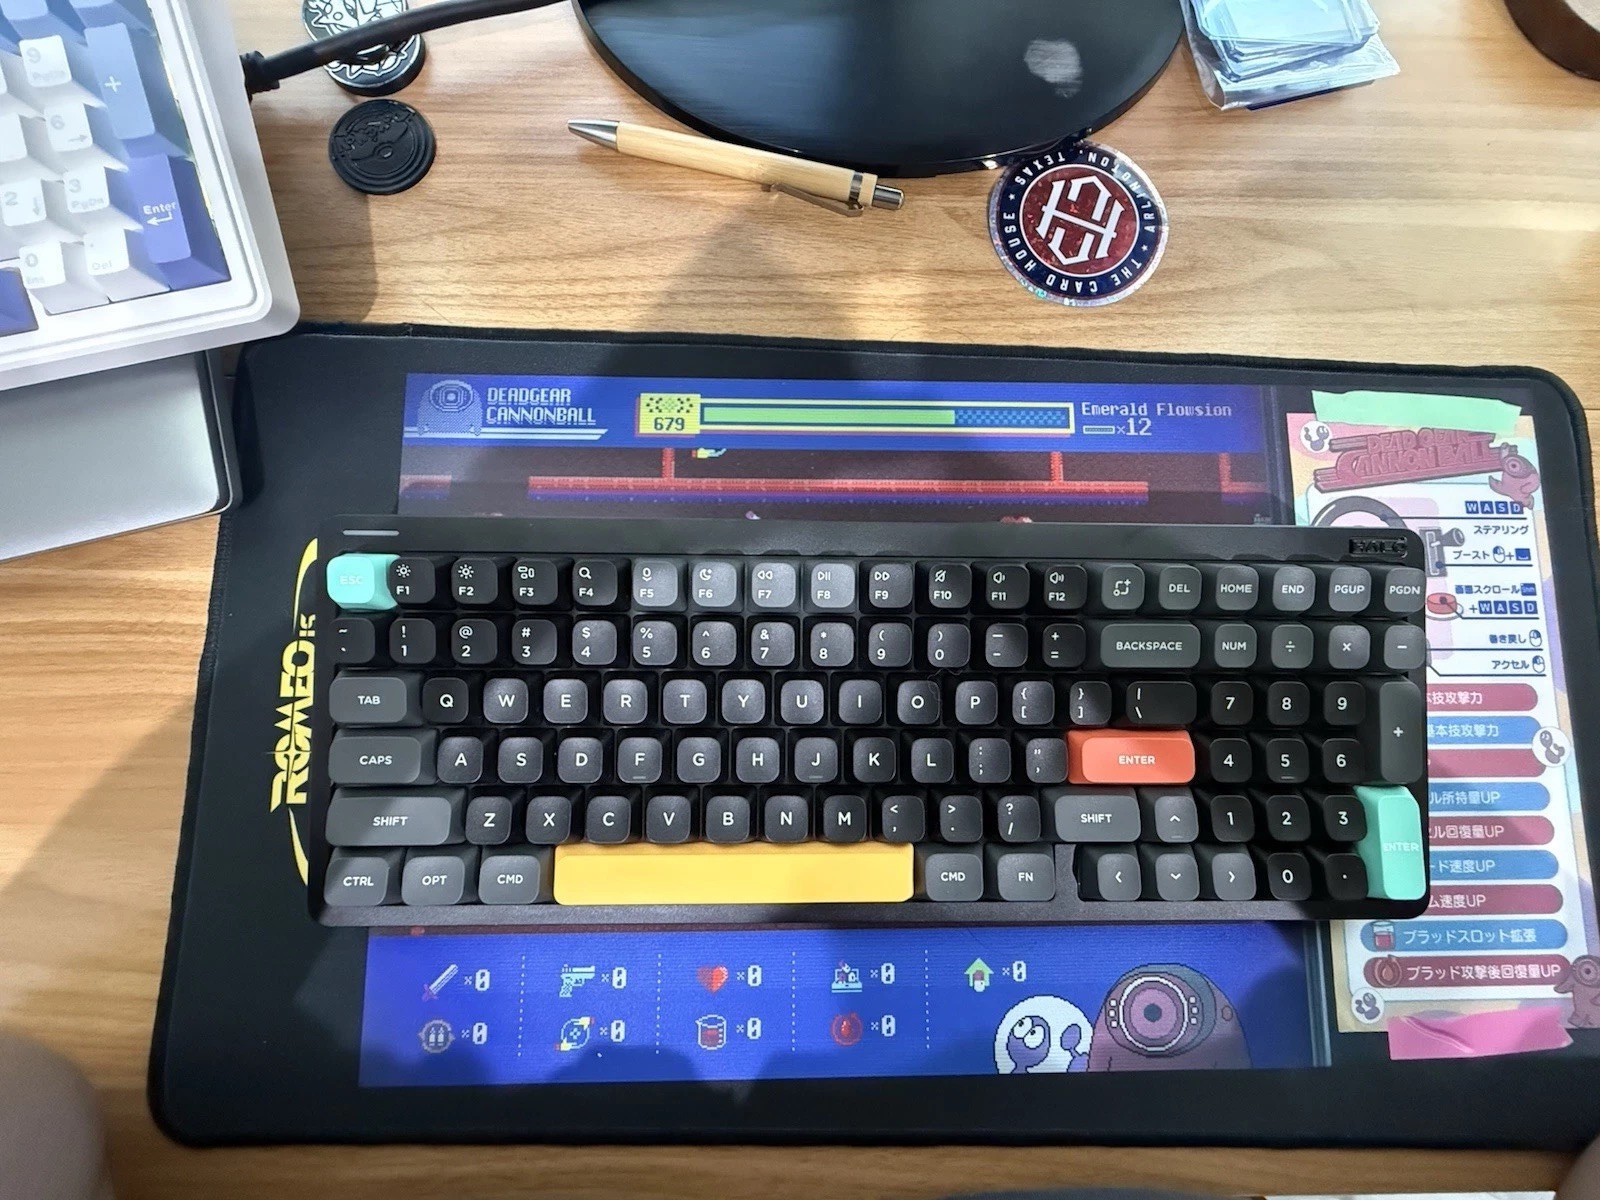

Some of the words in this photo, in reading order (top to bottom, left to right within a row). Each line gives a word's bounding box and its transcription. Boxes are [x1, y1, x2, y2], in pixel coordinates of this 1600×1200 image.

[26, 47, 41, 63] 9
[50, 115, 65, 130] 6
[1015, 151, 1065, 186] TEXAS
[68, 178, 82, 193] 3
[4, 192, 18, 206] 2
[142, 201, 177, 215] Enter
[1003, 212, 1037, 273] HOUSE
[1111, 258, 1142, 286] THE
[1046, 274, 1098, 293] CARD
[487, 387, 572, 405] DEADGEAR
[486, 407, 596, 425] CANNONBALL
[1081, 402, 1148, 416] Emerald
[1156, 403, 1232, 417] Flowsion
[653, 416, 686, 432] 679
[1473, 525, 1529, 535] ステアリング
[1452, 550, 1490, 560] ブースト
[339, 575, 364, 586] ESC
[396, 585, 410, 595] F1
[458, 586, 474, 596] F2
[519, 587, 534, 597] F3
[578, 587, 594, 597] F4
[639, 588, 655, 598] F5
[698, 588, 713, 599] F6
[758, 589, 772, 599] F7
[817, 590, 831, 600] F8
[874, 590, 889, 600] F9
[933, 590, 952, 600] F10
[1168, 583, 1191, 593] DEL
[1220, 583, 1253, 594] HOME
[1281, 584, 1305, 594] END
[1334, 584, 1365, 595] PGUP
[1389, 585, 1421, 595] PGDN
[1455, 584, 1520, 595] スクロール
[991, 591, 1007, 601] F11
[1048, 591, 1066, 602] F12
[1116, 641, 1183, 651] BACKSPACE
[1221, 641, 1247, 651] NUM
[1489, 634, 1526, 644] き戻し
[401, 644, 407, 657] 1
[461, 645, 471, 657] 2
[521, 645, 531, 658] 3
[580, 645, 591, 658] 4
[642, 646, 652, 658] 5
[701, 646, 711, 659] 6
[760, 646, 770, 660] 7
[819, 647, 828, 660] 8
[877, 648, 886, 660] 9
[934, 648, 945, 661] 0
[1491, 660, 1530, 670] アクセル
[357, 695, 381, 705] TAB
[439, 693, 454, 708] Q
[497, 694, 516, 708] W
[560, 693, 572, 708] E
[620, 694, 632, 708] R
[679, 694, 691, 708] T
[737, 694, 750, 708] Y
[796, 694, 808, 709] U
[911, 695, 925, 709] O
[970, 695, 981, 709] P
[1225, 696, 1236, 710] 7
[1281, 696, 1292, 711] 8
[1337, 696, 1348, 711] 9
[269, 640, 316, 813] ROMEO
[359, 755, 393, 766] CAPS
[454, 752, 468, 767] A
[516, 752, 527, 767] S
[575, 752, 589, 767] D
[634, 752, 646, 766] F
[692, 752, 705, 767] G
[752, 752, 764, 767] H
[811, 752, 821, 767] J
[868, 752, 880, 767] K
[926, 753, 937, 767] L
[1118, 755, 1156, 765] ENTER
[1223, 753, 1234, 767] 4
[1280, 753, 1290, 768] 5
[1336, 753, 1347, 768] 6
[373, 816, 409, 827] SHIFT
[483, 812, 496, 828] Z
[543, 812, 556, 827] X
[602, 811, 615, 827] C
[663, 811, 676, 827] V
[722, 811, 734, 826] B
[780, 811, 793, 826] N
[838, 811, 851, 826] M
[1080, 813, 1112, 823] SHIFT
[1226, 811, 1234, 826] 1
[1281, 811, 1292, 826] 2
[1338, 811, 1349, 825] 3
[1382, 843, 1420, 852] ENTER
[342, 876, 375, 887] CTRL
[421, 874, 448, 886] OPT
[496, 874, 524, 885] CMD
[940, 871, 966, 882] CMD
[1018, 872, 1034, 882] FN
[1282, 869, 1294, 884] 0
[1403, 928, 1537, 944] ブラッドスロット拡張
[1406, 964, 1561, 981] ブラッド攻撃後回復量UP
